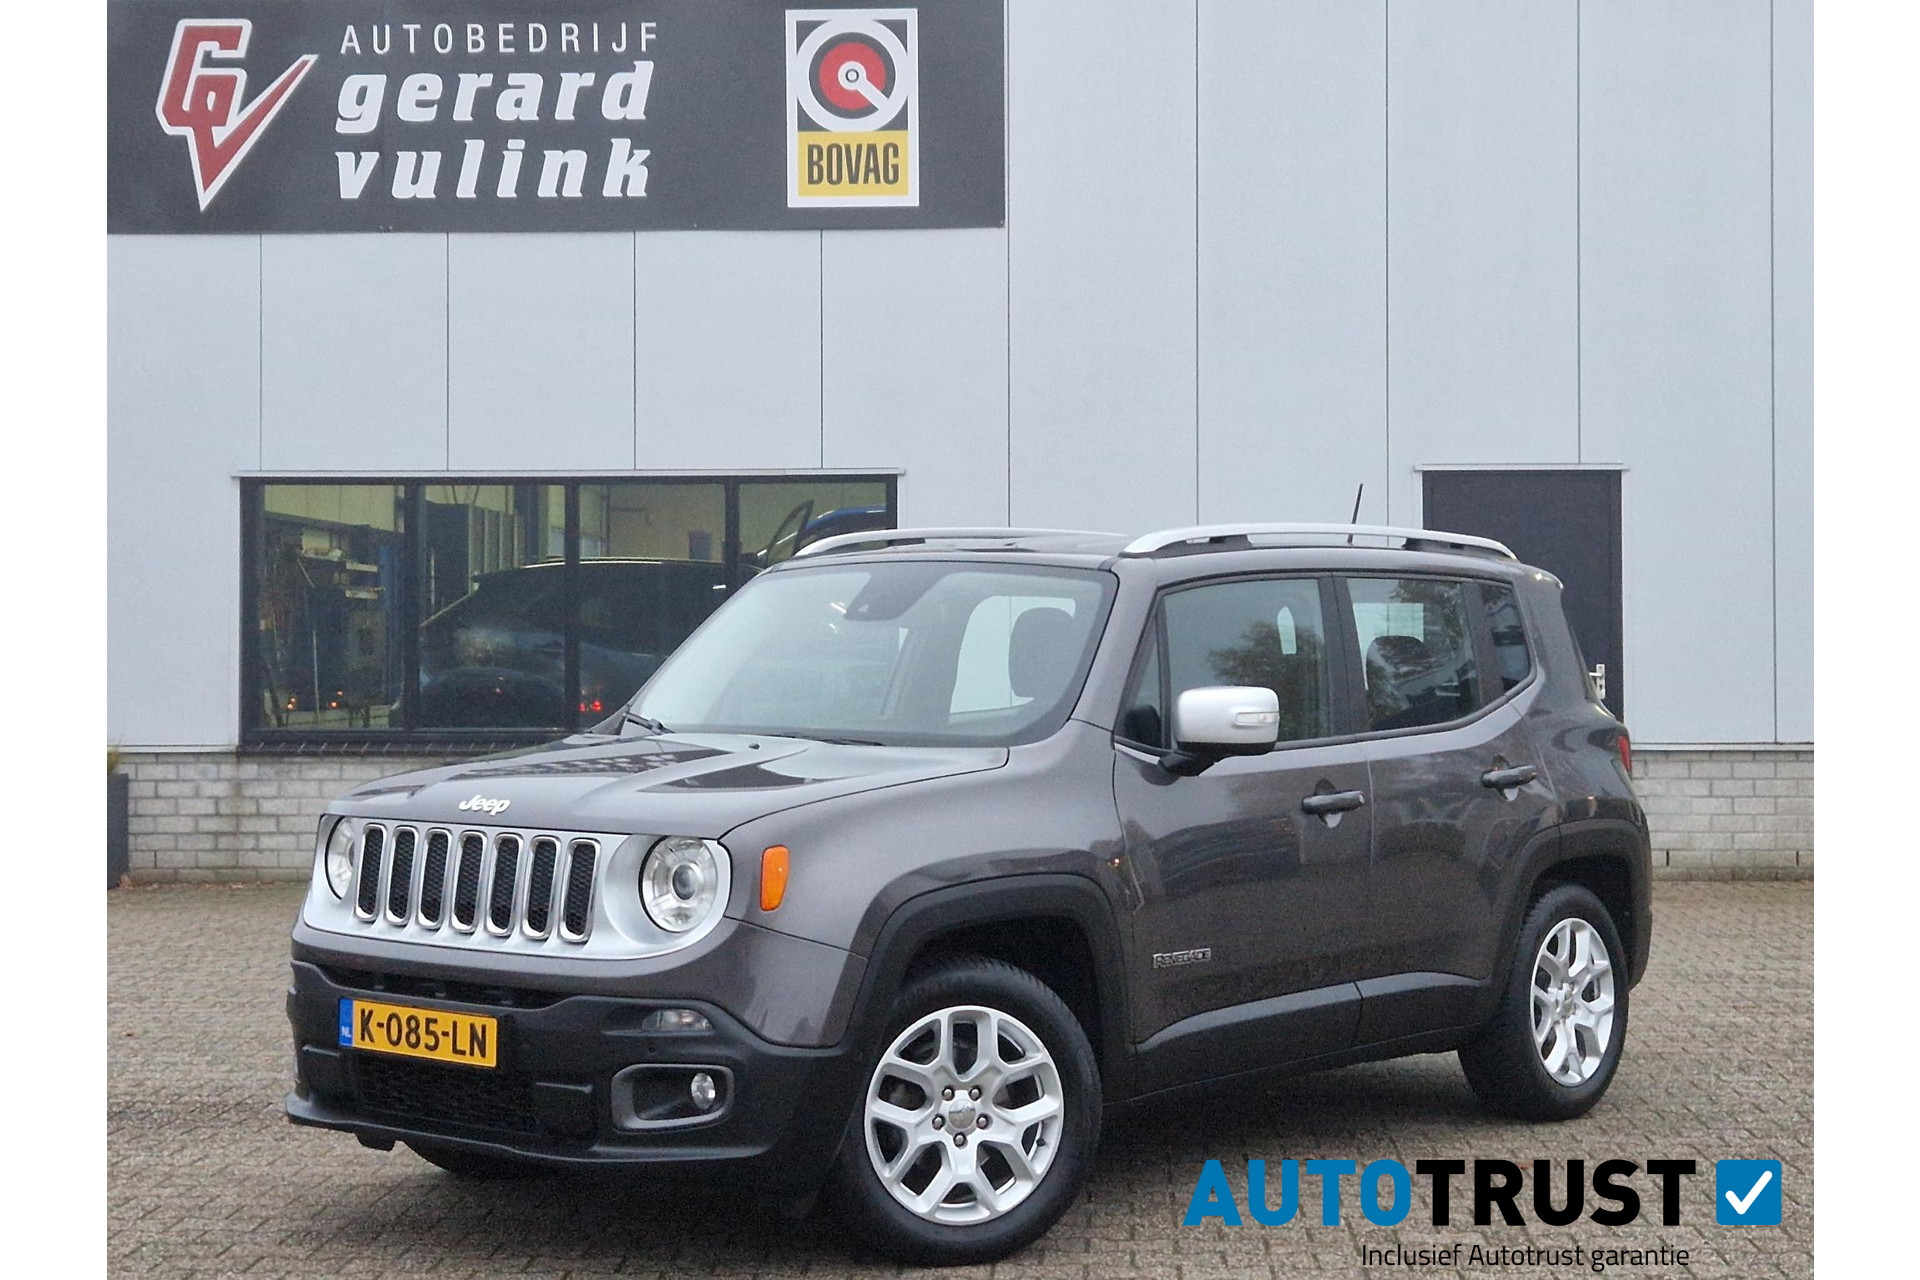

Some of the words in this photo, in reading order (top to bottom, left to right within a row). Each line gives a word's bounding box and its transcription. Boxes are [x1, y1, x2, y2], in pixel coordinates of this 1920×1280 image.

[340, 22, 658, 55] AUTOBEDRIJF
[335, 60, 654, 134] gerard
[335, 138, 652, 199] vulink
[807, 142, 900, 186] BOVAG
[458, 794, 511, 816] Jeep
[1153, 947, 1212, 969] RENEGADE
[341, 1025, 352, 1038] NL
[360, 1007, 488, 1059] K-085-LN
